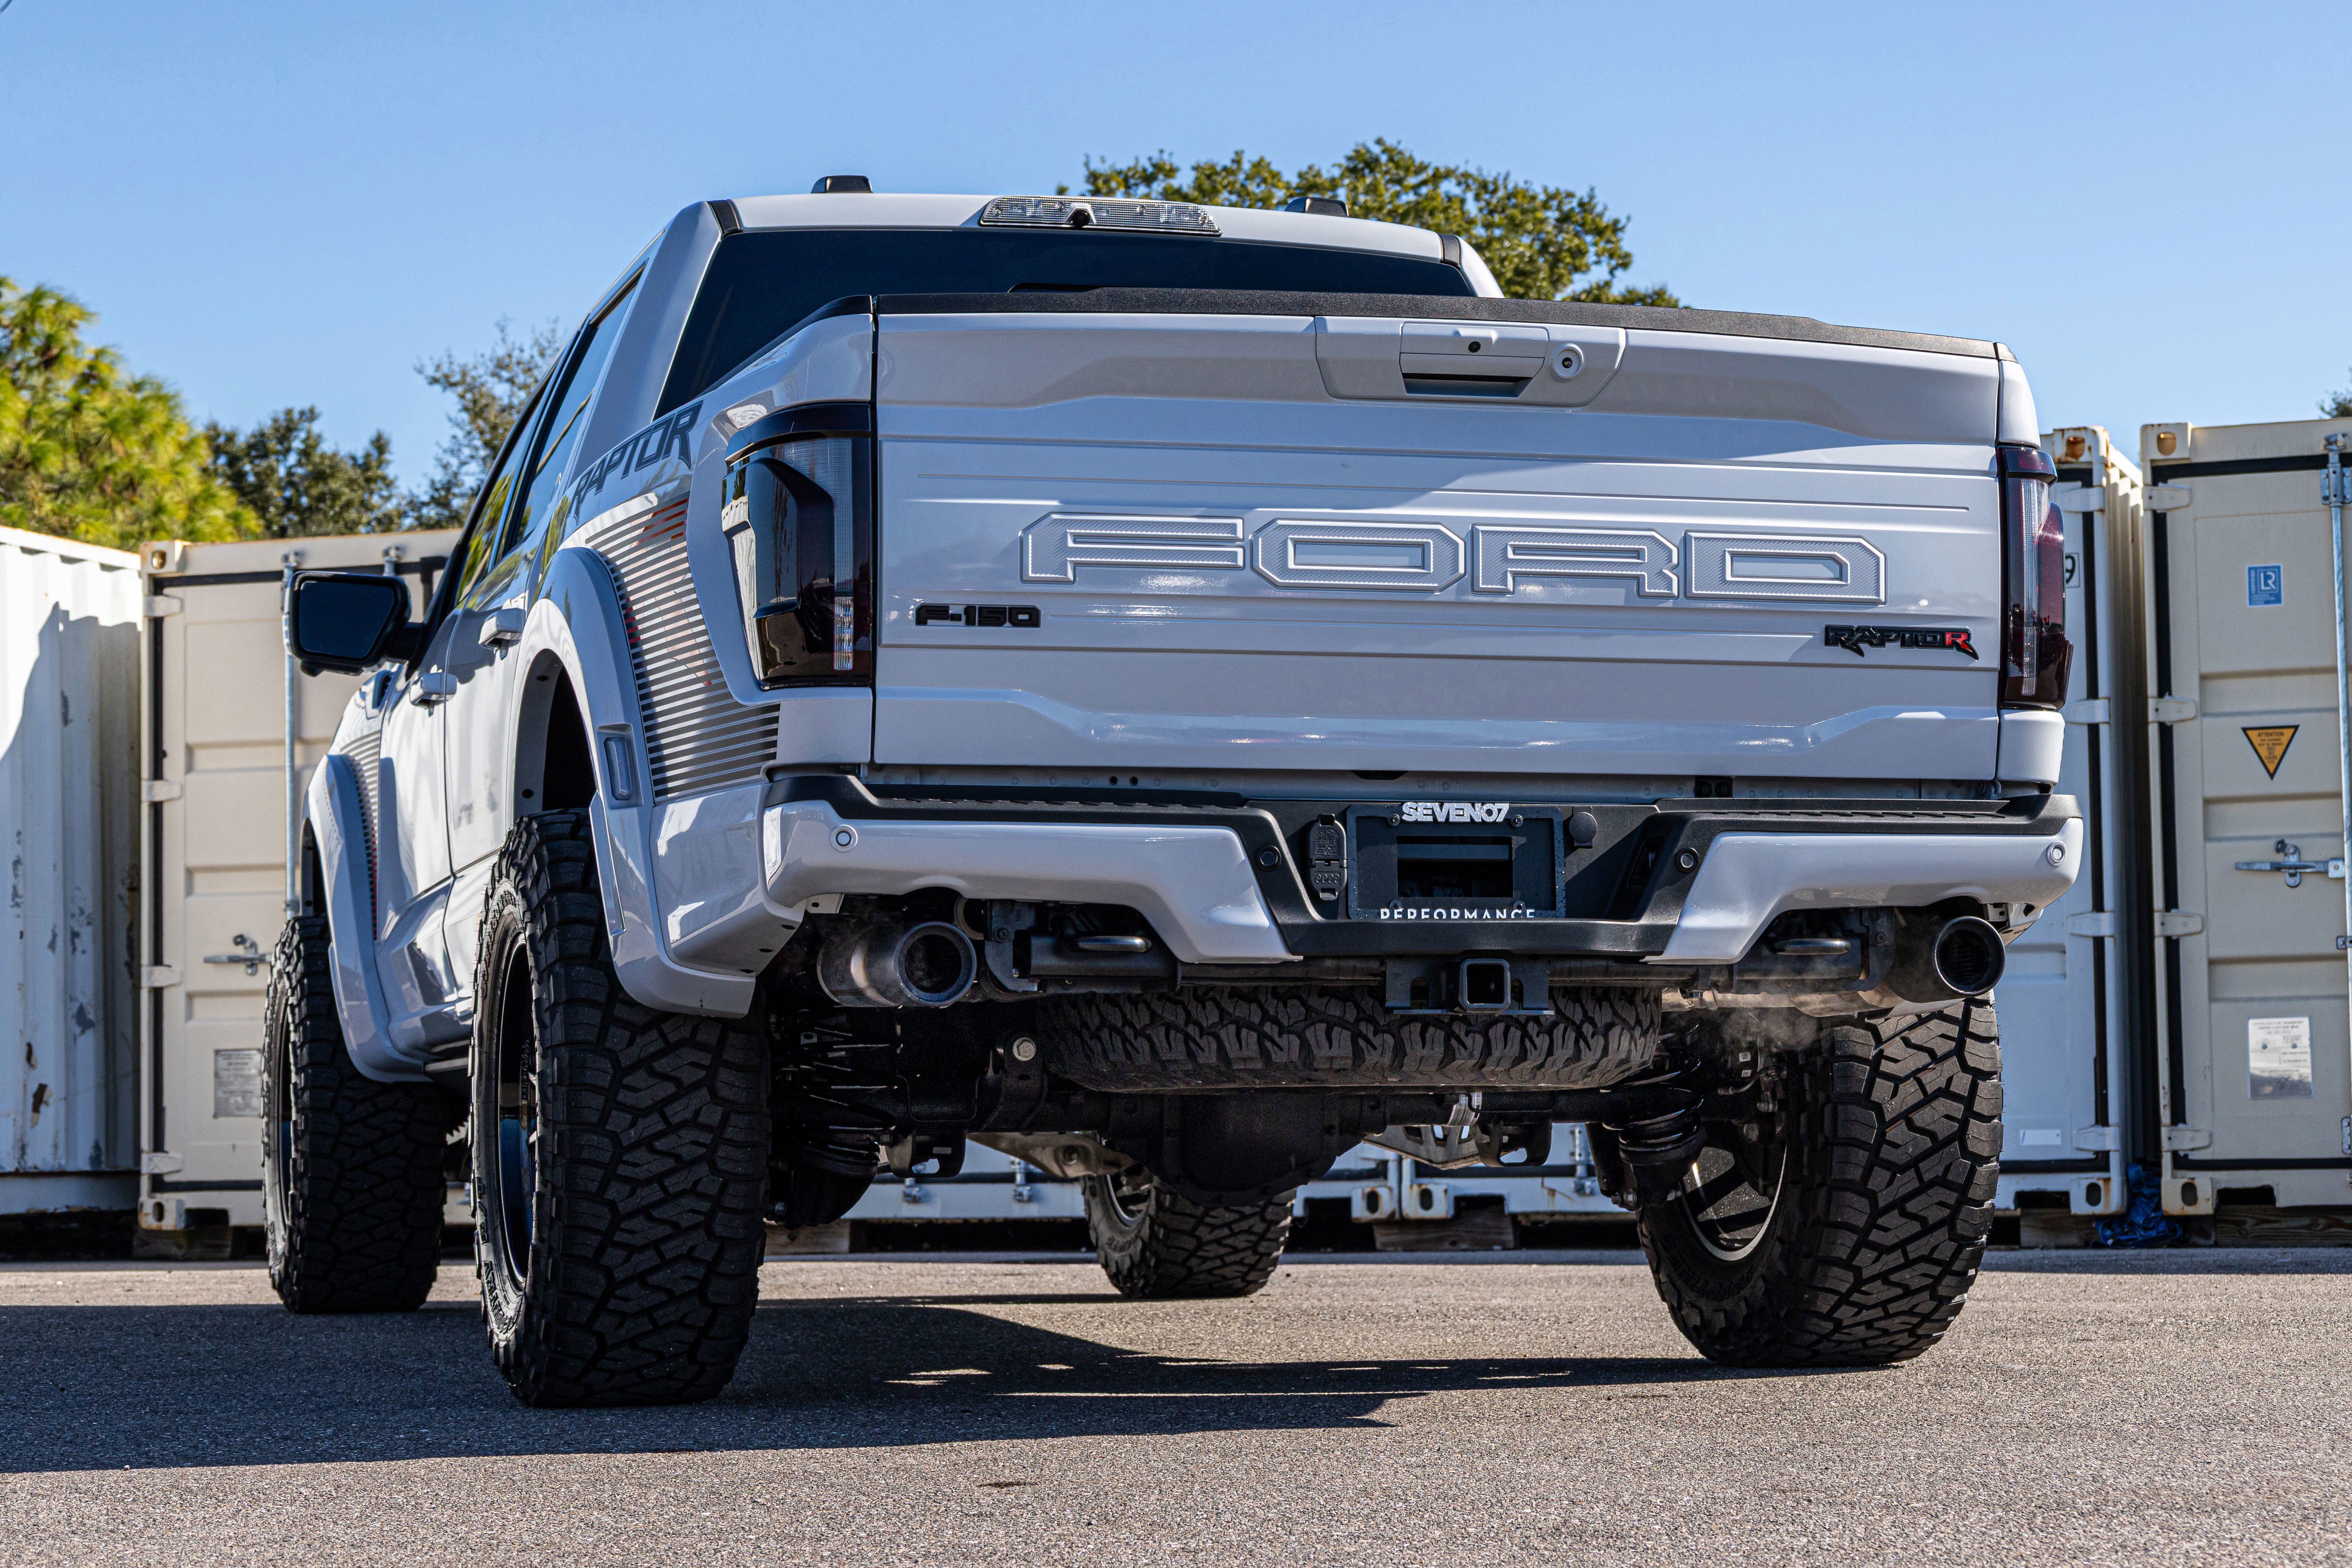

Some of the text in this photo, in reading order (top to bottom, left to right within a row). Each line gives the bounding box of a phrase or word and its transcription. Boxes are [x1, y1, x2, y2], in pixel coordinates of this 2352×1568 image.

[566, 400, 704, 526] RAPTOR
[1020, 512, 1886, 606] FORD
[2261, 571, 2276, 590] LR
[915, 603, 1041, 628] F-150
[1824, 624, 1979, 661] RAPTOR
